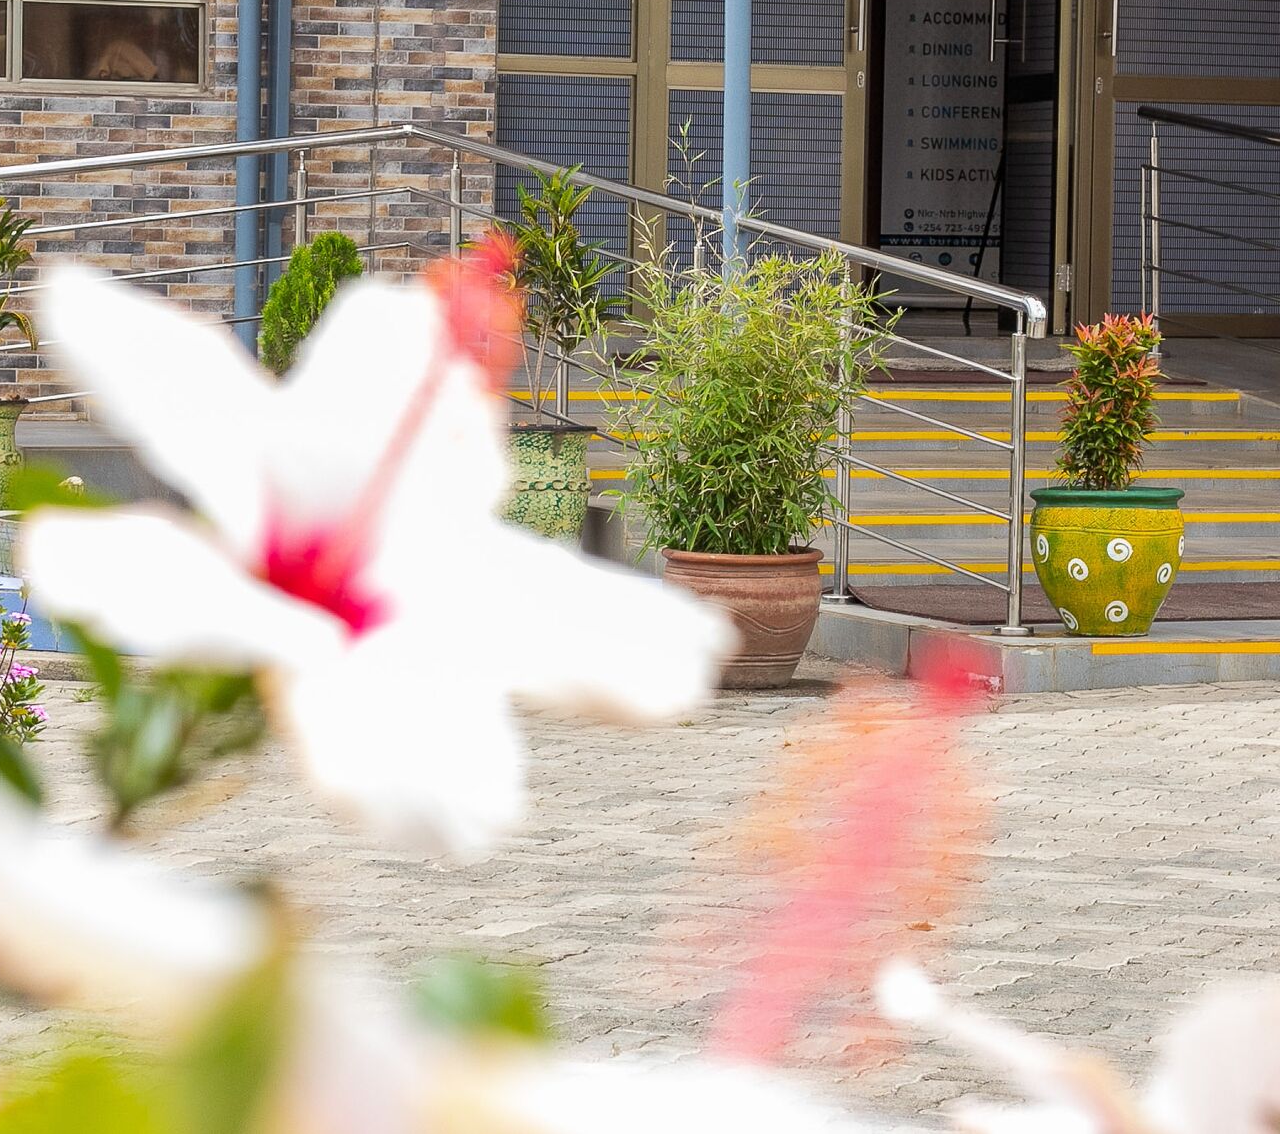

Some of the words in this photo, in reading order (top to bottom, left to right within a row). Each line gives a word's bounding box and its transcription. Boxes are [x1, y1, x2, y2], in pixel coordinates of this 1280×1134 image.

[922, 43, 973, 56] DINING
[922, 74, 998, 88] LOUNGING
[921, 106, 1004, 120] CONFEREN
[920, 136, 998, 151] SWIMMING
[920, 168, 955, 181] KIDS
